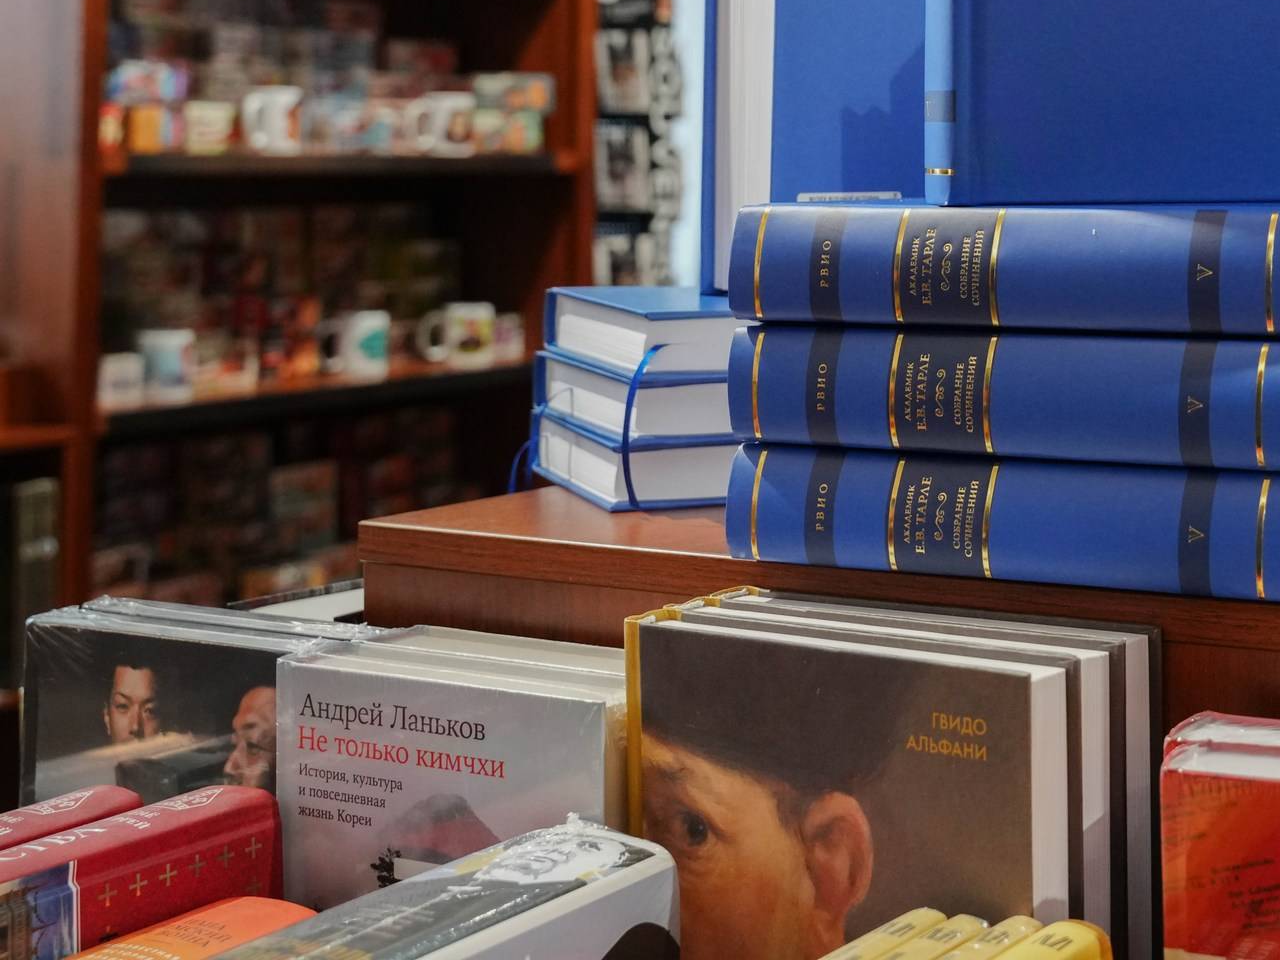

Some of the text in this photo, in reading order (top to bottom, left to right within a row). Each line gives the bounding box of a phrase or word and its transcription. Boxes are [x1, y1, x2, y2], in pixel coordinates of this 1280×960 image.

[820, 240, 832, 288] РВИО
[909, 237, 921, 296] АКАДЕМИК
[922, 228, 937, 305] Е.В. ТАРЛЕ
[960, 236, 972, 298] СОБРАНИЕ
[971, 230, 985, 306] СОЧИНЕНИЙ
[817, 363, 828, 412] РВИО
[904, 362, 914, 421] АКАДЕМИК
[917, 353, 931, 432] Е.В. ТАРЛЕ
[954, 362, 965, 425] СОБРАНИЕ
[965, 355, 978, 433] СОЧИНЕНИЙ
[816, 483, 829, 532] РВИО
[904, 485, 916, 544] АКАДЕМИК
[915, 476, 932, 555] Е.В. ТАРЛЕ
[952, 487, 966, 550] СОБРАНИЕ
[964, 480, 979, 558] СОЧИНЕНИЙ
[300, 693, 486, 740] Андрей Ланьков
[932, 712, 987, 736] ГВИДО
[297, 725, 505, 778] Не только кимчхи
[906, 735, 987, 761] АЛЬФАНИ
[299, 763, 403, 793] История, культура
[299, 786, 386, 808] и повседневная
[298, 805, 372, 828] жизнь Кореи
